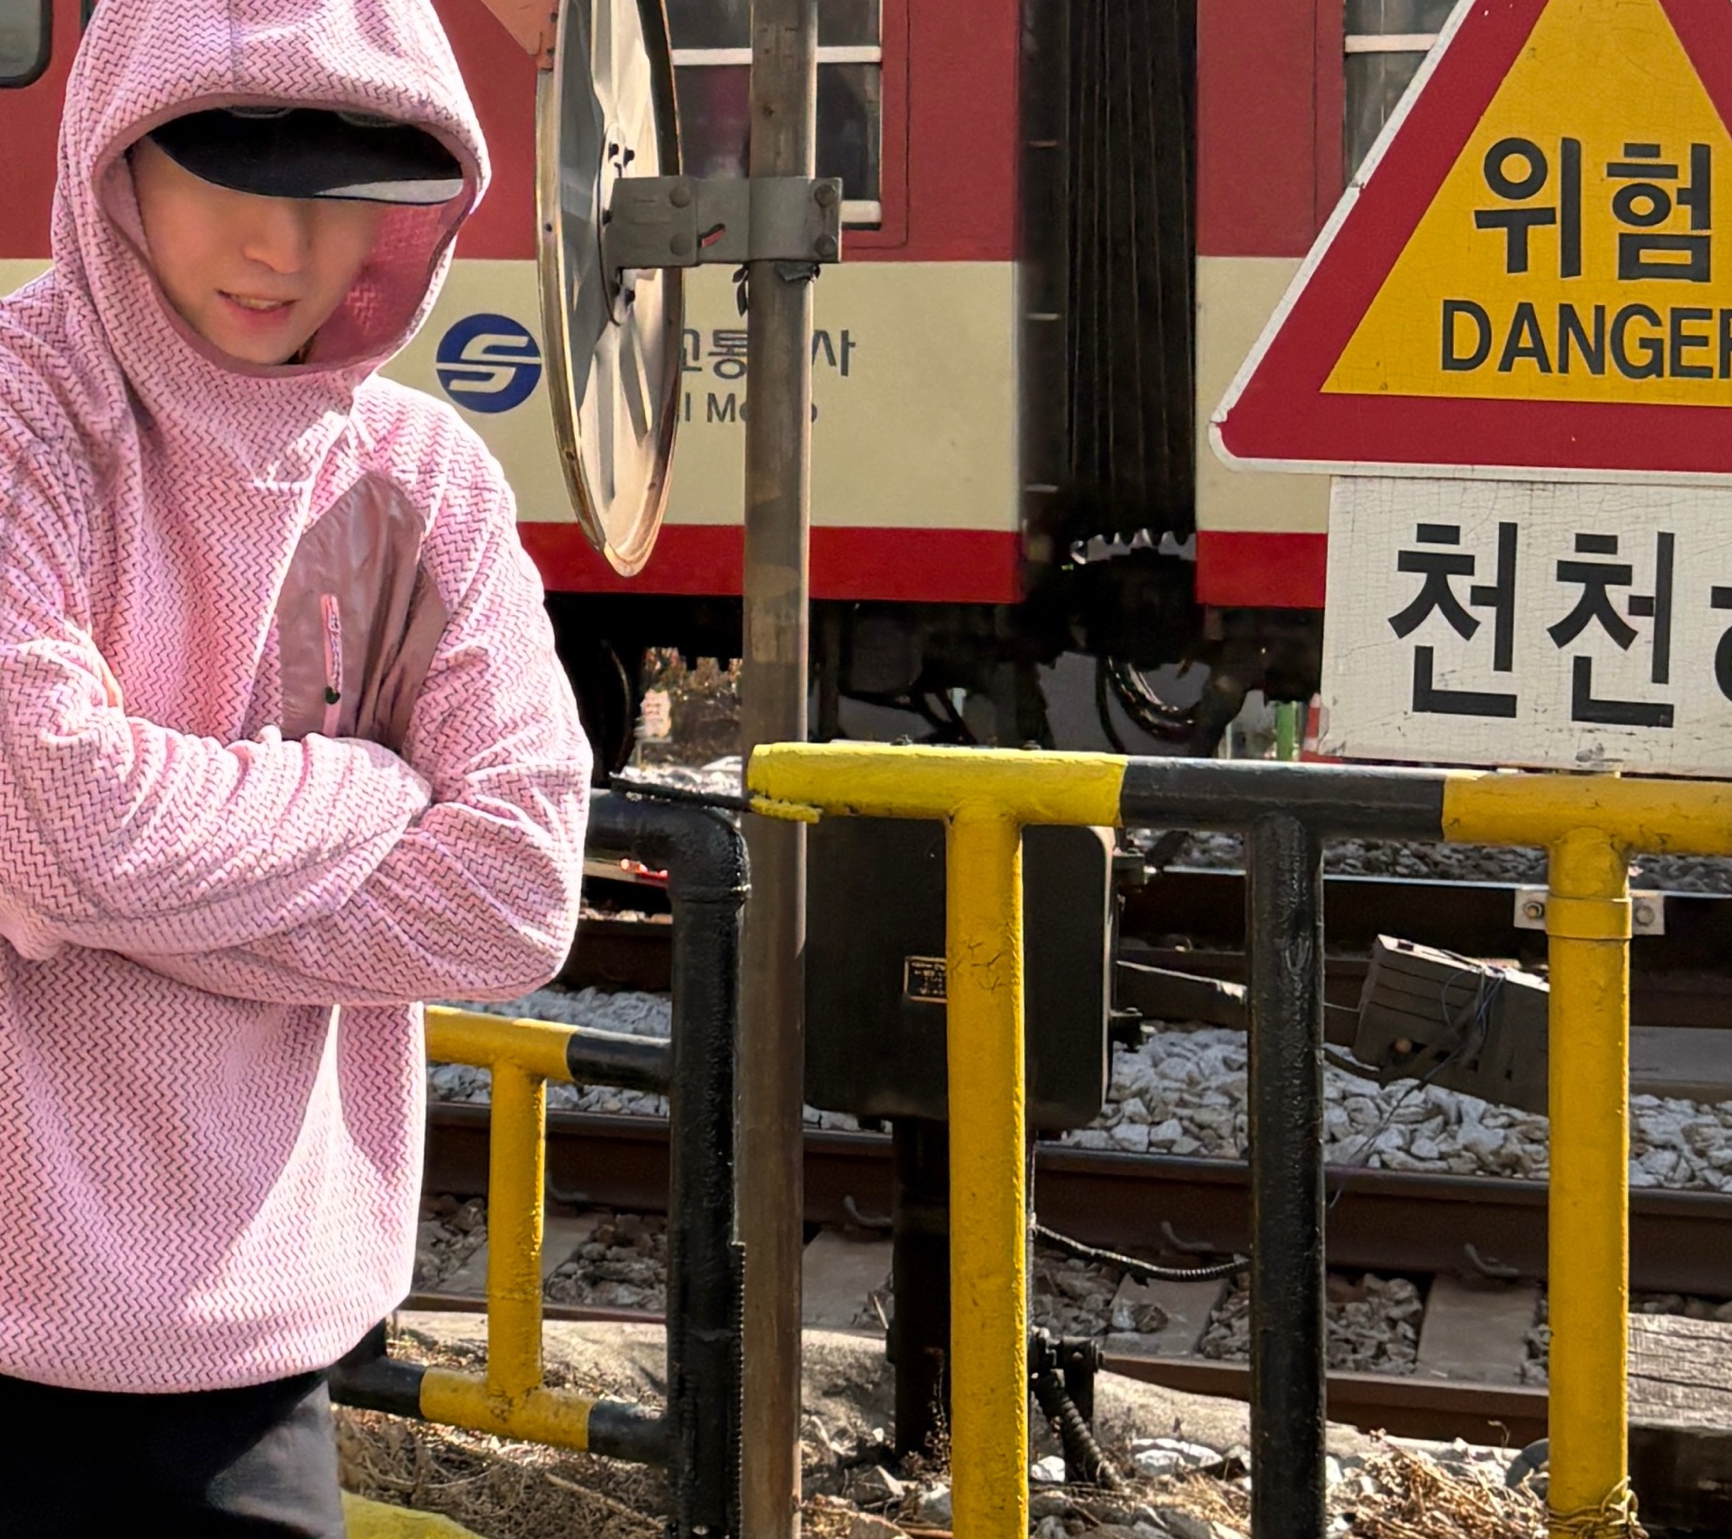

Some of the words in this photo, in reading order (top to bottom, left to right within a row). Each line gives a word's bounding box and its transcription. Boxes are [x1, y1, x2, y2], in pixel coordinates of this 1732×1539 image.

[1474, 136, 1712, 283] 위험
[1442, 299, 1732, 379] DANGE
[1388, 521, 1732, 728] 천천
